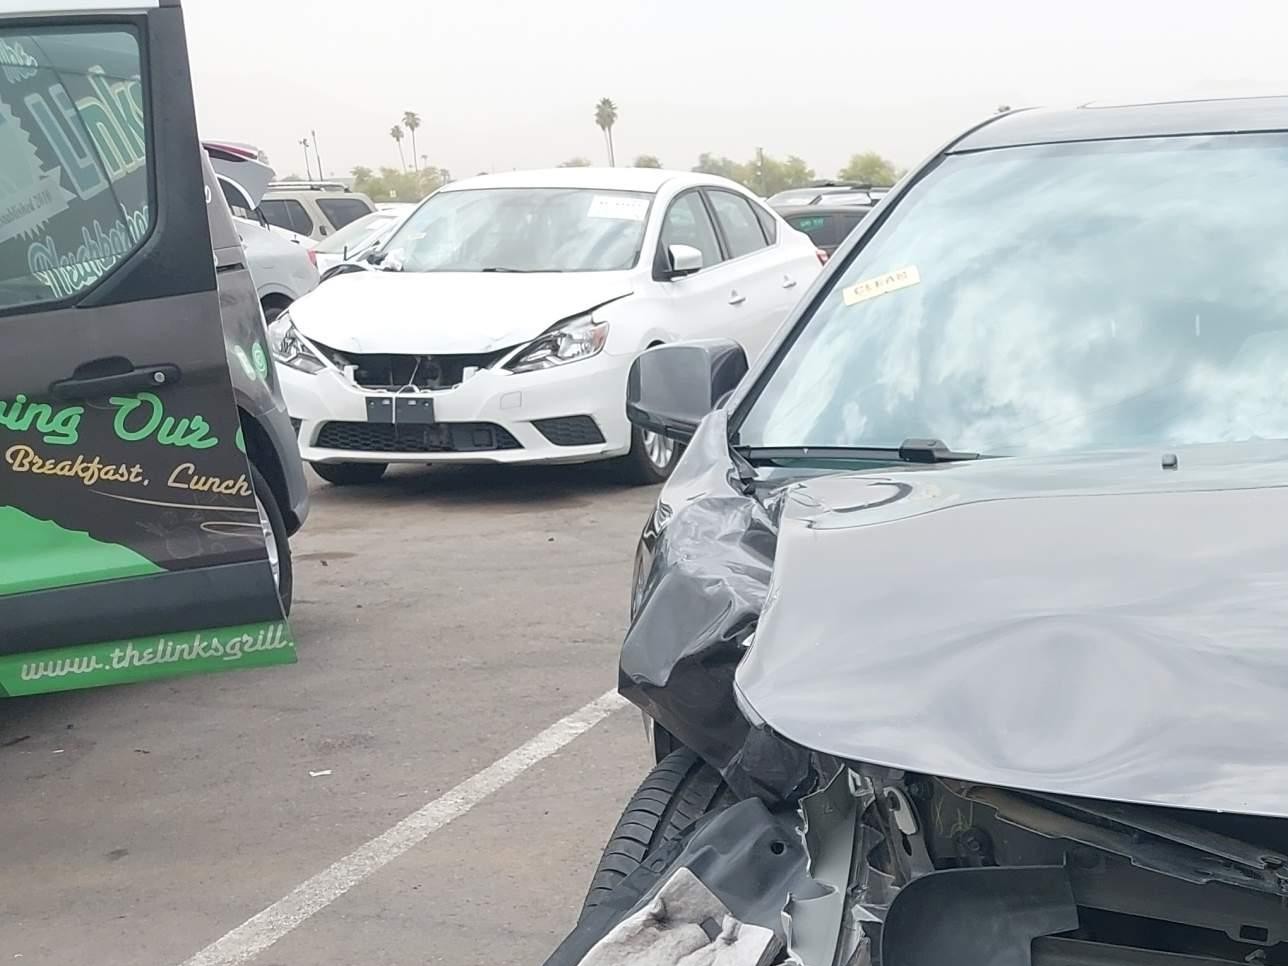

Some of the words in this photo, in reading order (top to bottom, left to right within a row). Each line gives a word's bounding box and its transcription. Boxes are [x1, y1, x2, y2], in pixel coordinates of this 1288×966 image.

[109, 393, 218, 449] Our
[5, 445, 149, 485] Breakfast,
[168, 463, 251, 496] Lunch
